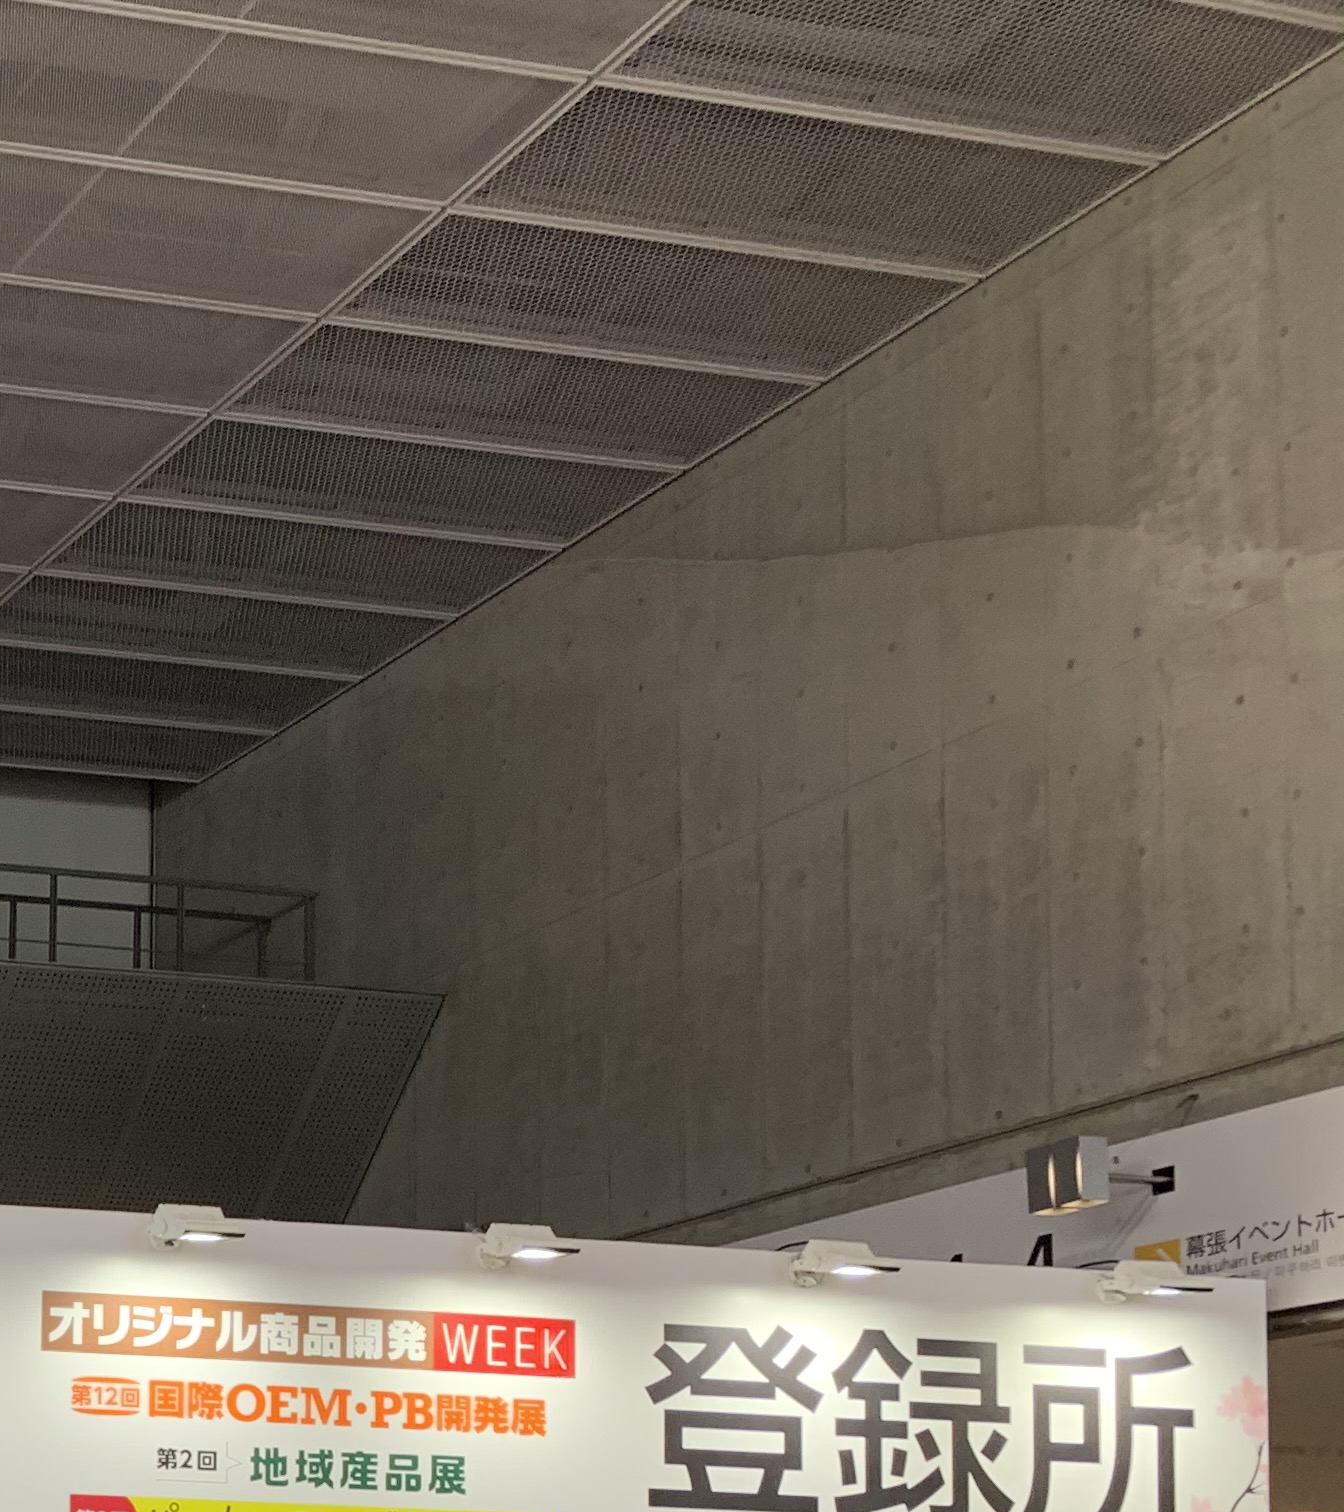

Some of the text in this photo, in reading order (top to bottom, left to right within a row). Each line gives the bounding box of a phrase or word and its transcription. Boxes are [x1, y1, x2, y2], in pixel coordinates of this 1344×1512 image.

[1293, 1239, 1319, 1257] Hall
[71, 1380, 547, 1436] 第12回 国際OEM・PB開発展
[156, 1447, 466, 1495] 第2回 地域産品展
